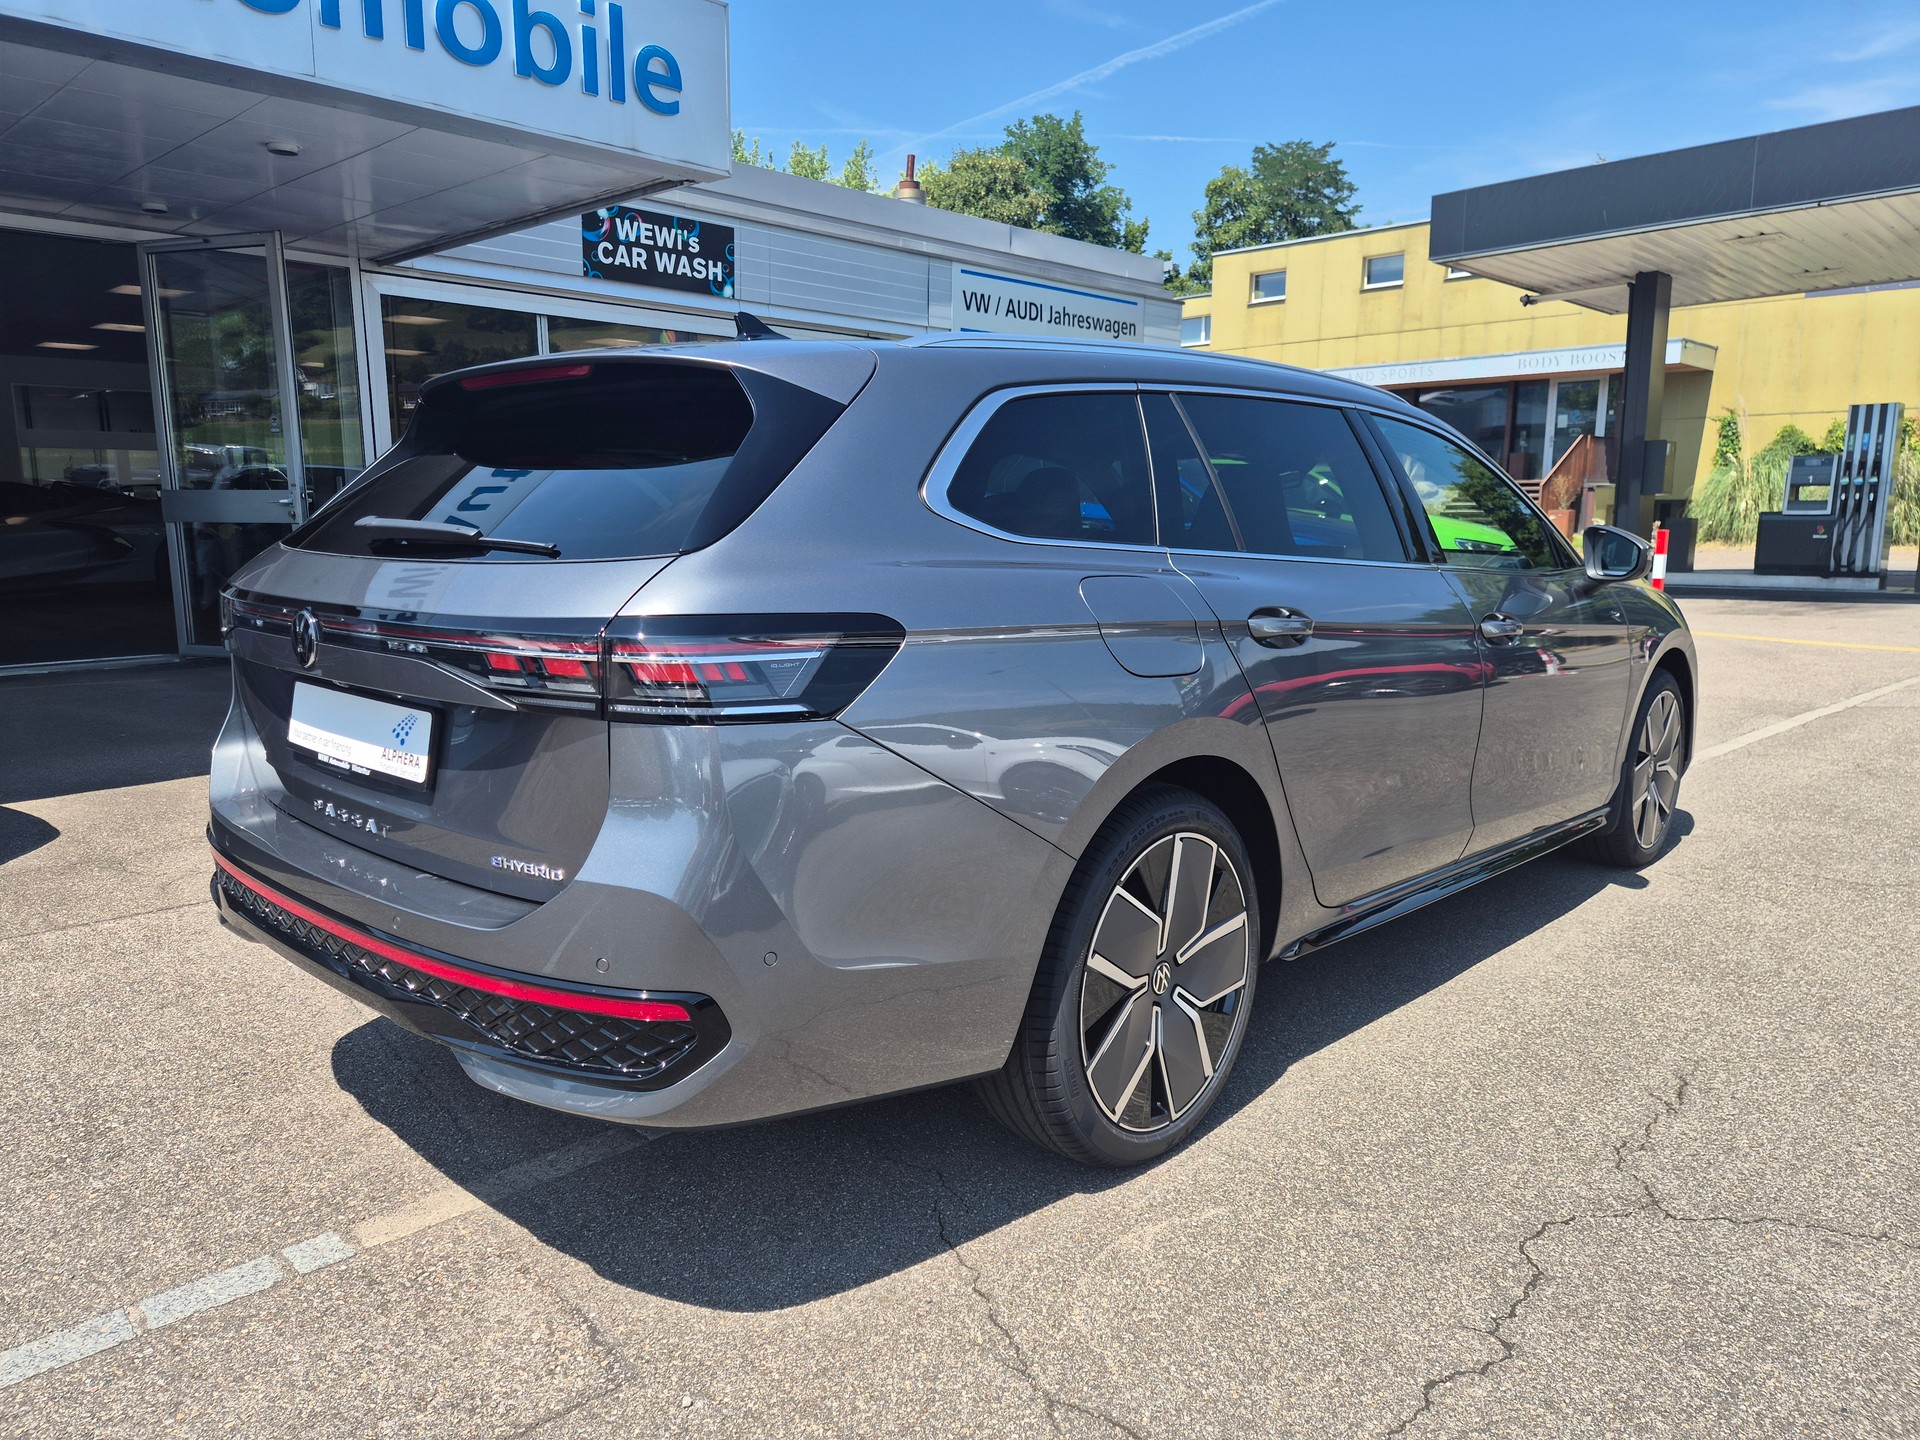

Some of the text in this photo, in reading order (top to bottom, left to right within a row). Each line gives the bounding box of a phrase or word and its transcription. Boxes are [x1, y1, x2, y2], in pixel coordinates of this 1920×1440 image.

[615, 217, 700, 253] WEWi's
[597, 241, 723, 282] CAR WASH
[962, 290, 1136, 339] VW / AUDI Jahreswagen
[1380, 365, 1434, 381] SPORTS
[1518, 356, 1561, 370] BODY
[1808, 475, 1814, 483] 1
[381, 747, 421, 769] ALPHERA
[313, 800, 392, 838] PASSAT
